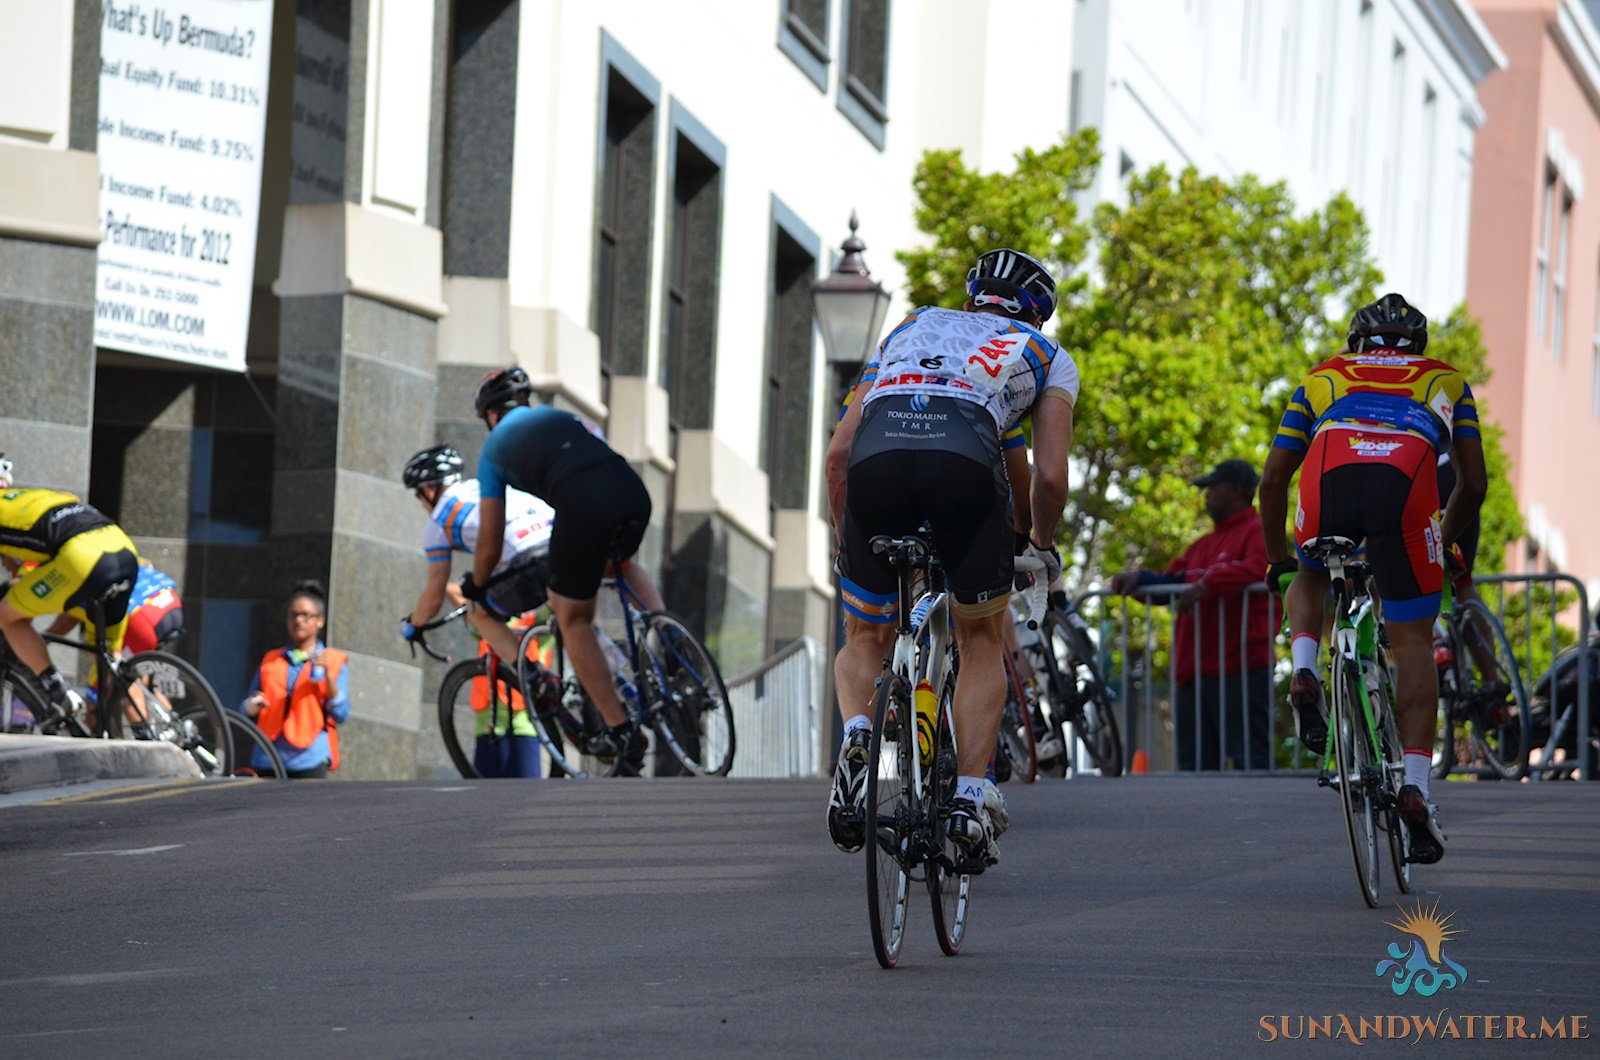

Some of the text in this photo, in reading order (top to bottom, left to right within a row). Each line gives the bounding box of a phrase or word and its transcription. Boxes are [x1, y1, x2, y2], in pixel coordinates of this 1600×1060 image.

[103, 0, 256, 59] hat's Up Bermuda?
[125, 61, 163, 90] Equity
[167, 70, 205, 96] Fund:
[209, 80, 260, 105] 10.31%
[119, 118, 165, 145] Income
[170, 129, 206, 154] Fund:
[210, 138, 254, 162] 9.75%
[108, 176, 154, 201] Income
[159, 185, 194, 209] Fund:
[199, 194, 242, 217] 4.02%
[103, 209, 232, 265] Performance for 2012
[105, 277, 122, 292] Call
[95, 299, 205, 336] WWW.LOM.COM
[968, 339, 1018, 378] 244
[887, 410, 949, 421] TOKIO MARINE
